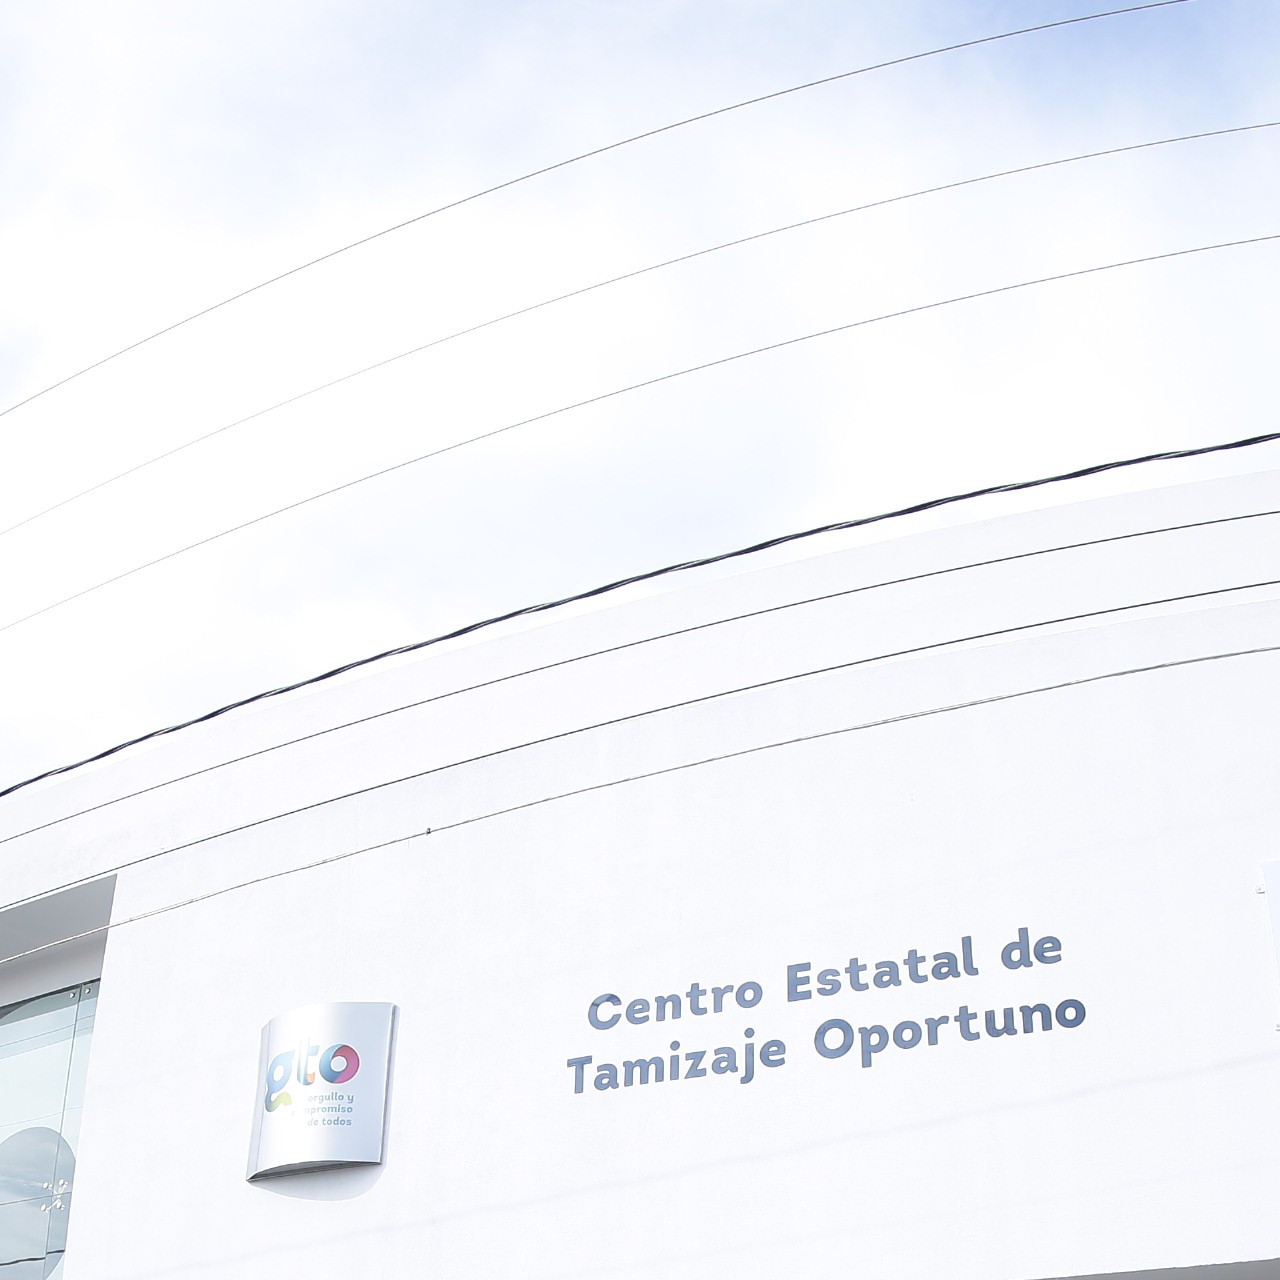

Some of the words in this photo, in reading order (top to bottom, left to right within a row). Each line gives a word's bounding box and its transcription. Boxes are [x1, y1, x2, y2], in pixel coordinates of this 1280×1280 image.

[587, 979, 763, 1031] Centro
[786, 935, 979, 1002] Estatal
[999, 926, 1062, 971] de
[264, 1038, 360, 1113] gto
[566, 1028, 786, 1095] Tamizaje
[813, 998, 1087, 1069] Oportuno
[307, 1092, 344, 1104] orgullo
[347, 1093, 354, 1103] y
[307, 1118, 318, 1126] de
[322, 1117, 352, 1126] todos
